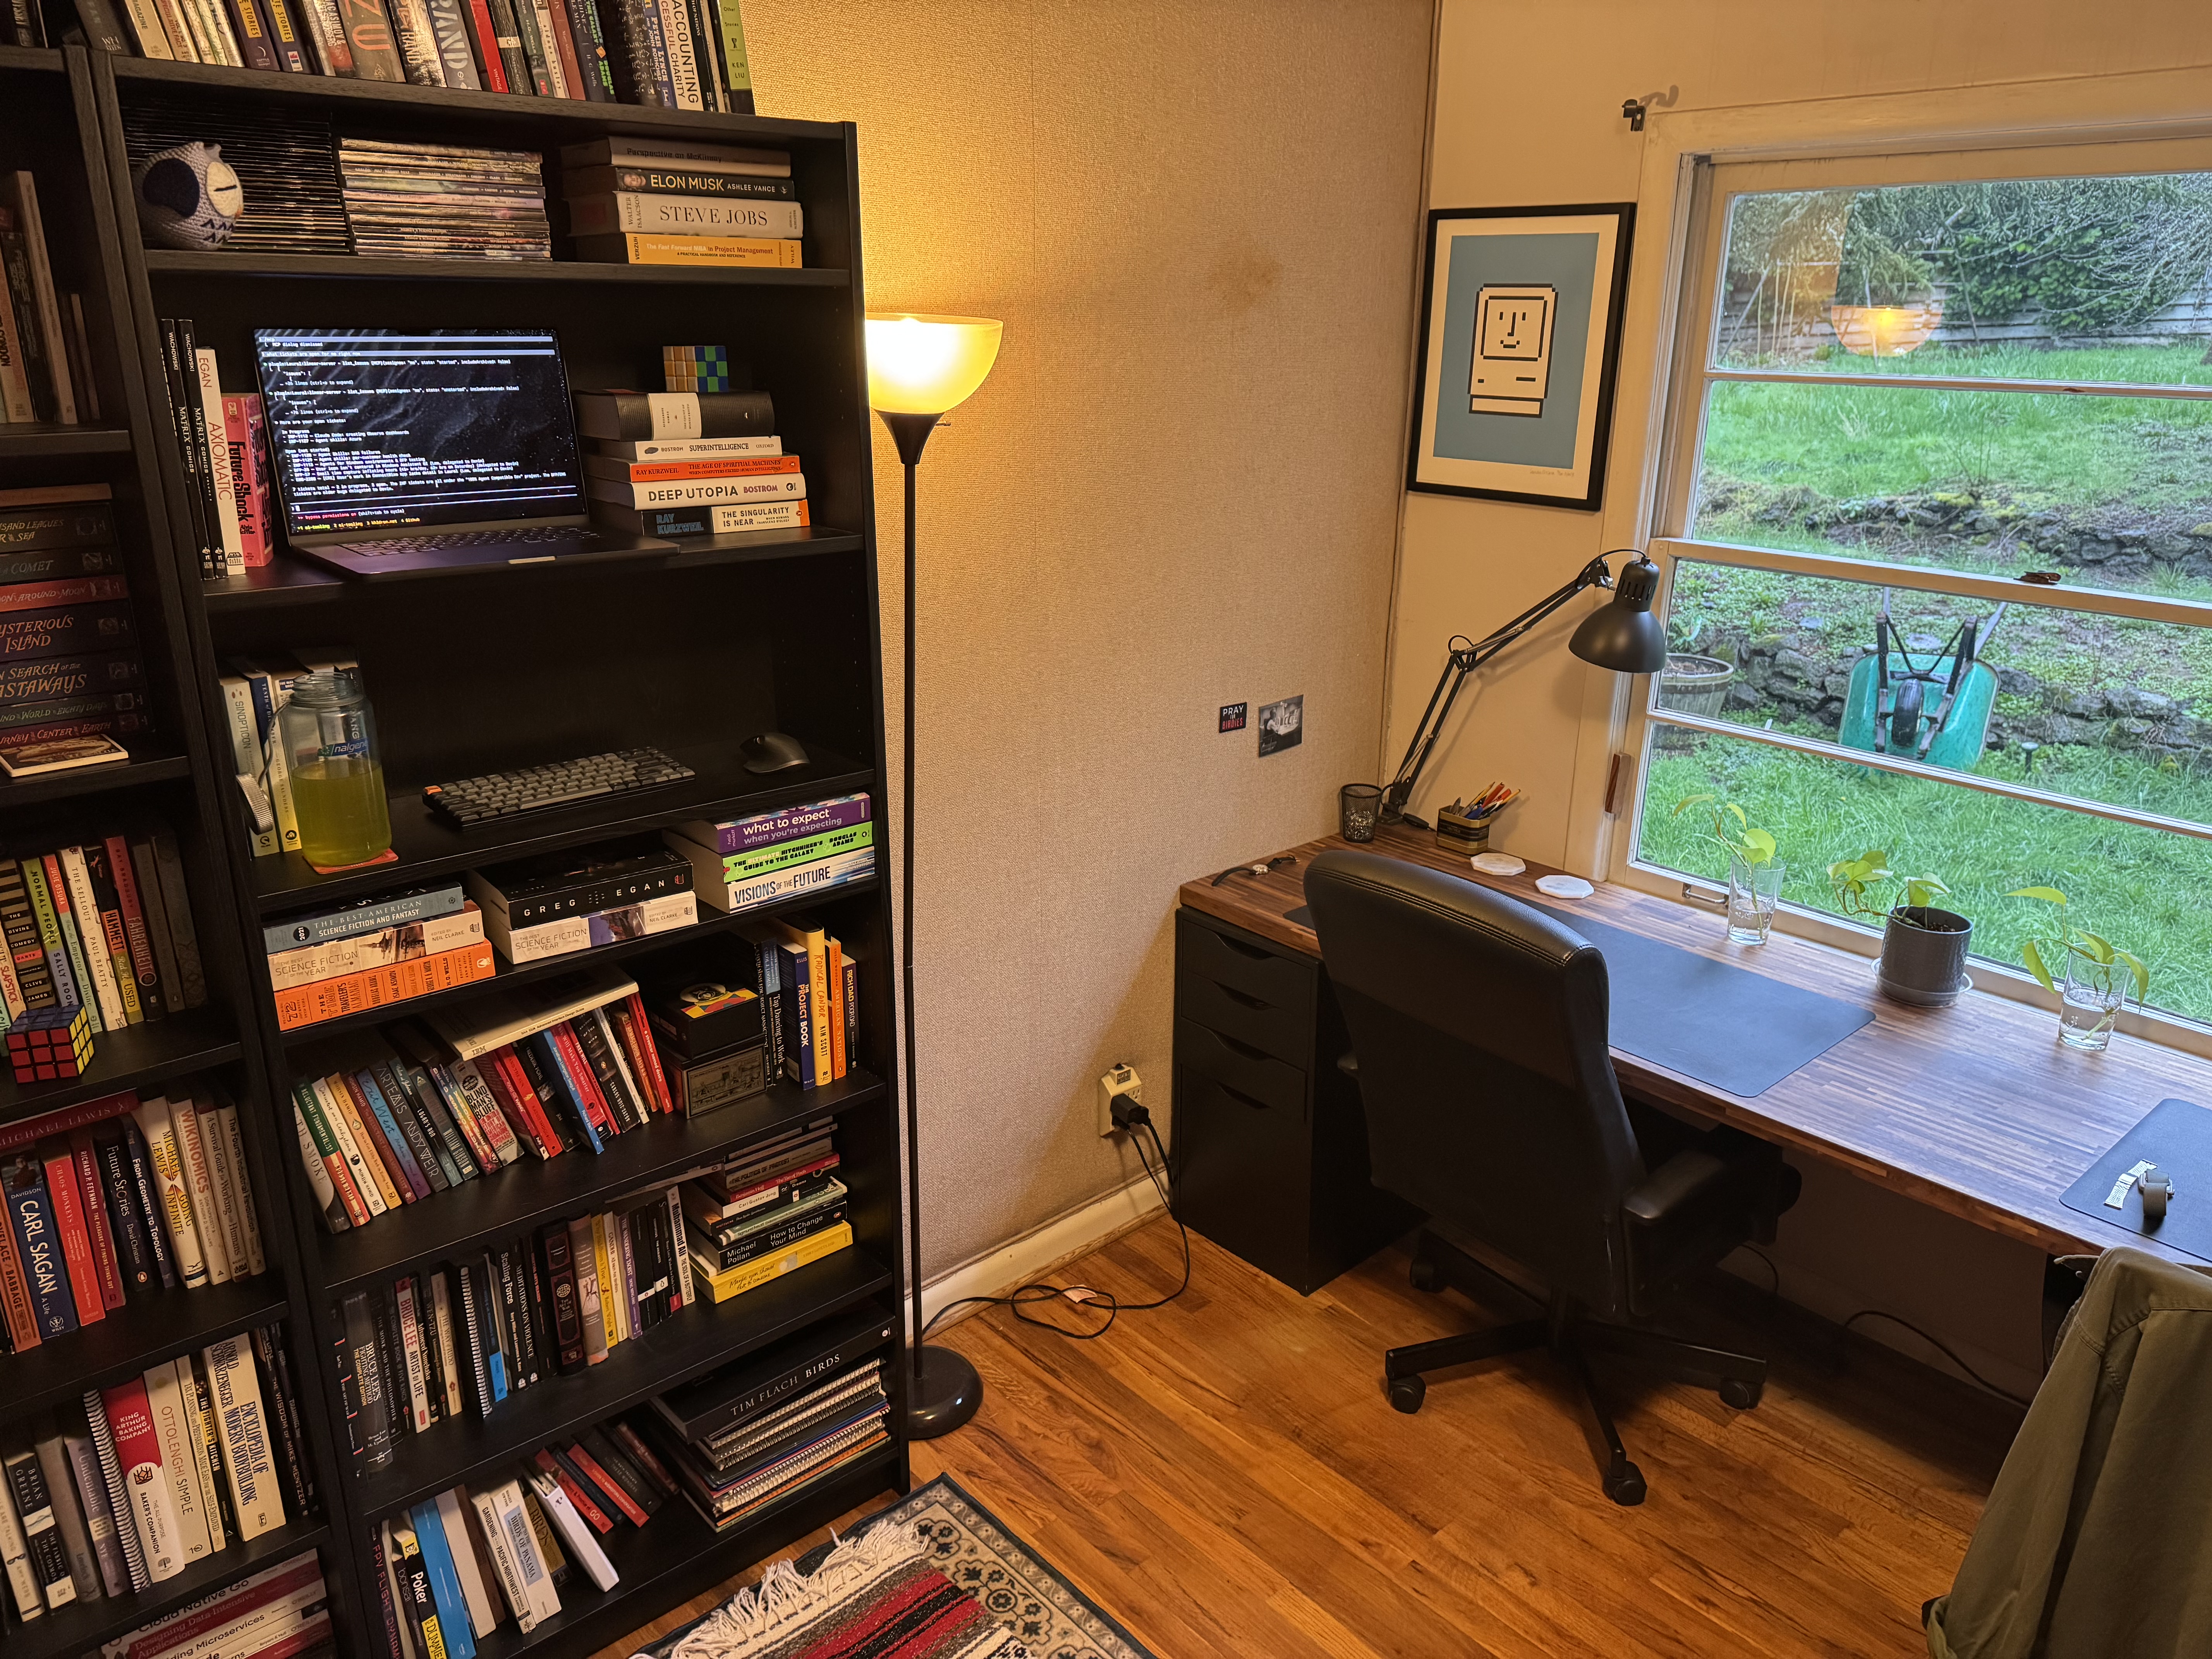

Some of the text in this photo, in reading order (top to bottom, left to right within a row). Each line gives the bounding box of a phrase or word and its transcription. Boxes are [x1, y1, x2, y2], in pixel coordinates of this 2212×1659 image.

[243, 5, 259, 35] STORIES
[401, 32, 421, 64] RAND
[652, 17, 668, 81] PETER LYNCH
[652, 47, 662, 81] ROTHCHILD
[671, 53, 685, 98] CHARITY
[493, 69, 502, 90] VINTAGE
[651, 174, 686, 189] ELON
[689, 177, 724, 191] MUSK
[660, 206, 767, 226] STEVE JOBS
[169, 332, 179, 370] WACHOWSKI
[185, 333, 194, 371] WACHOWSKI
[199, 358, 212, 388] EGAN
[179, 407, 191, 443] MATRIX
[194, 407, 205, 443] MATRIX
[208, 422, 232, 500] AXIOMATIC
[228, 441, 253, 522] Future Shock
[649, 484, 778, 501] DEEP UTOPIA BOSTROM
[656, 514, 675, 524] RAY
[740, 507, 789, 516] SINGULARITY
[16, 532, 35, 541] SEA
[658, 522, 704, 534] KURZWEIL
[11, 560, 53, 574] COMET
[11, 664, 59, 678] SEARCH
[1222, 718, 1243, 729] BIRDIES
[1223, 706, 1243, 716] PRAY
[235, 701, 252, 749] SINOPTICON
[743, 823, 774, 835] what
[792, 809, 830, 825] expect
[744, 817, 842, 844] when you're expecting
[829, 832, 857, 843] DOUGLAS
[833, 838, 854, 847] ADAMS
[524, 880, 665, 916] GREG EGAN
[734, 881, 776, 904] VISIONS
[783, 878, 793, 887] THE
[793, 867, 831, 888] FUTURE
[105, 913, 125, 951] HAMMETT
[318, 908, 420, 937] SCIENCE FICTION AND FANTASY
[10, 939, 35, 947] COMEDY
[275, 951, 358, 976] SCIENCE FICTION
[304, 967, 326, 976] YEAR
[124, 983, 136, 1007] USED
[814, 955, 826, 1017] RADICAL CANDOR
[798, 984, 809, 1047] PROJECT BOOK
[472, 1046, 486, 1056] IBM
[466, 1085, 487, 1104] BLIND
[471, 1094, 492, 1112] MAN'S
[376, 1068, 439, 1178] ARTEMIS ANDY WEIR
[474, 1103, 495, 1120] BLUFF
[151, 1142, 167, 1174] LEWIS
[162, 1131, 180, 1175] MICHAEL
[181, 1109, 209, 1193] WIKINOMICS
[11, 1188, 41, 1199] DAVIDSON
[107, 1145, 130, 1216] Future Stories
[165, 1192, 184, 1236] INFINITE
[179, 1194, 193, 1226] GOING
[672, 1203, 687, 1257] Muhammad Ali
[770, 1231, 787, 1240] How
[797, 1215, 824, 1230] Change
[771, 1229, 806, 1247] Your Mind
[20, 1200, 58, 1295] CARL SAGAN
[727, 1242, 756, 1258] Michael
[728, 1252, 750, 1264] Pollan
[400, 1298, 414, 1328] BRUCE
[405, 1328, 417, 1348] LEE
[409, 1351, 419, 1375] ARTIST
[805, 1354, 840, 1378] BIRDS
[414, 1381, 424, 1398] LIFE
[731, 1376, 798, 1415] TIM FLACH
[116, 1415, 146, 1430] ARTHUR
[118, 1422, 147, 1436] BAKING
[120, 1412, 139, 1422] KING
[115, 1424, 151, 1442] COMPANY
[161, 1406, 193, 1515] OTTOLENGHI SIMPLE
[16, 1470, 33, 1509] GREENE
[28, 1468, 43, 1500] BRIAN
[140, 1492, 161, 1553] BAKER'S COMPANION
[482, 1506, 498, 1538] GARDENING
[410, 1571, 428, 1604] Poker
